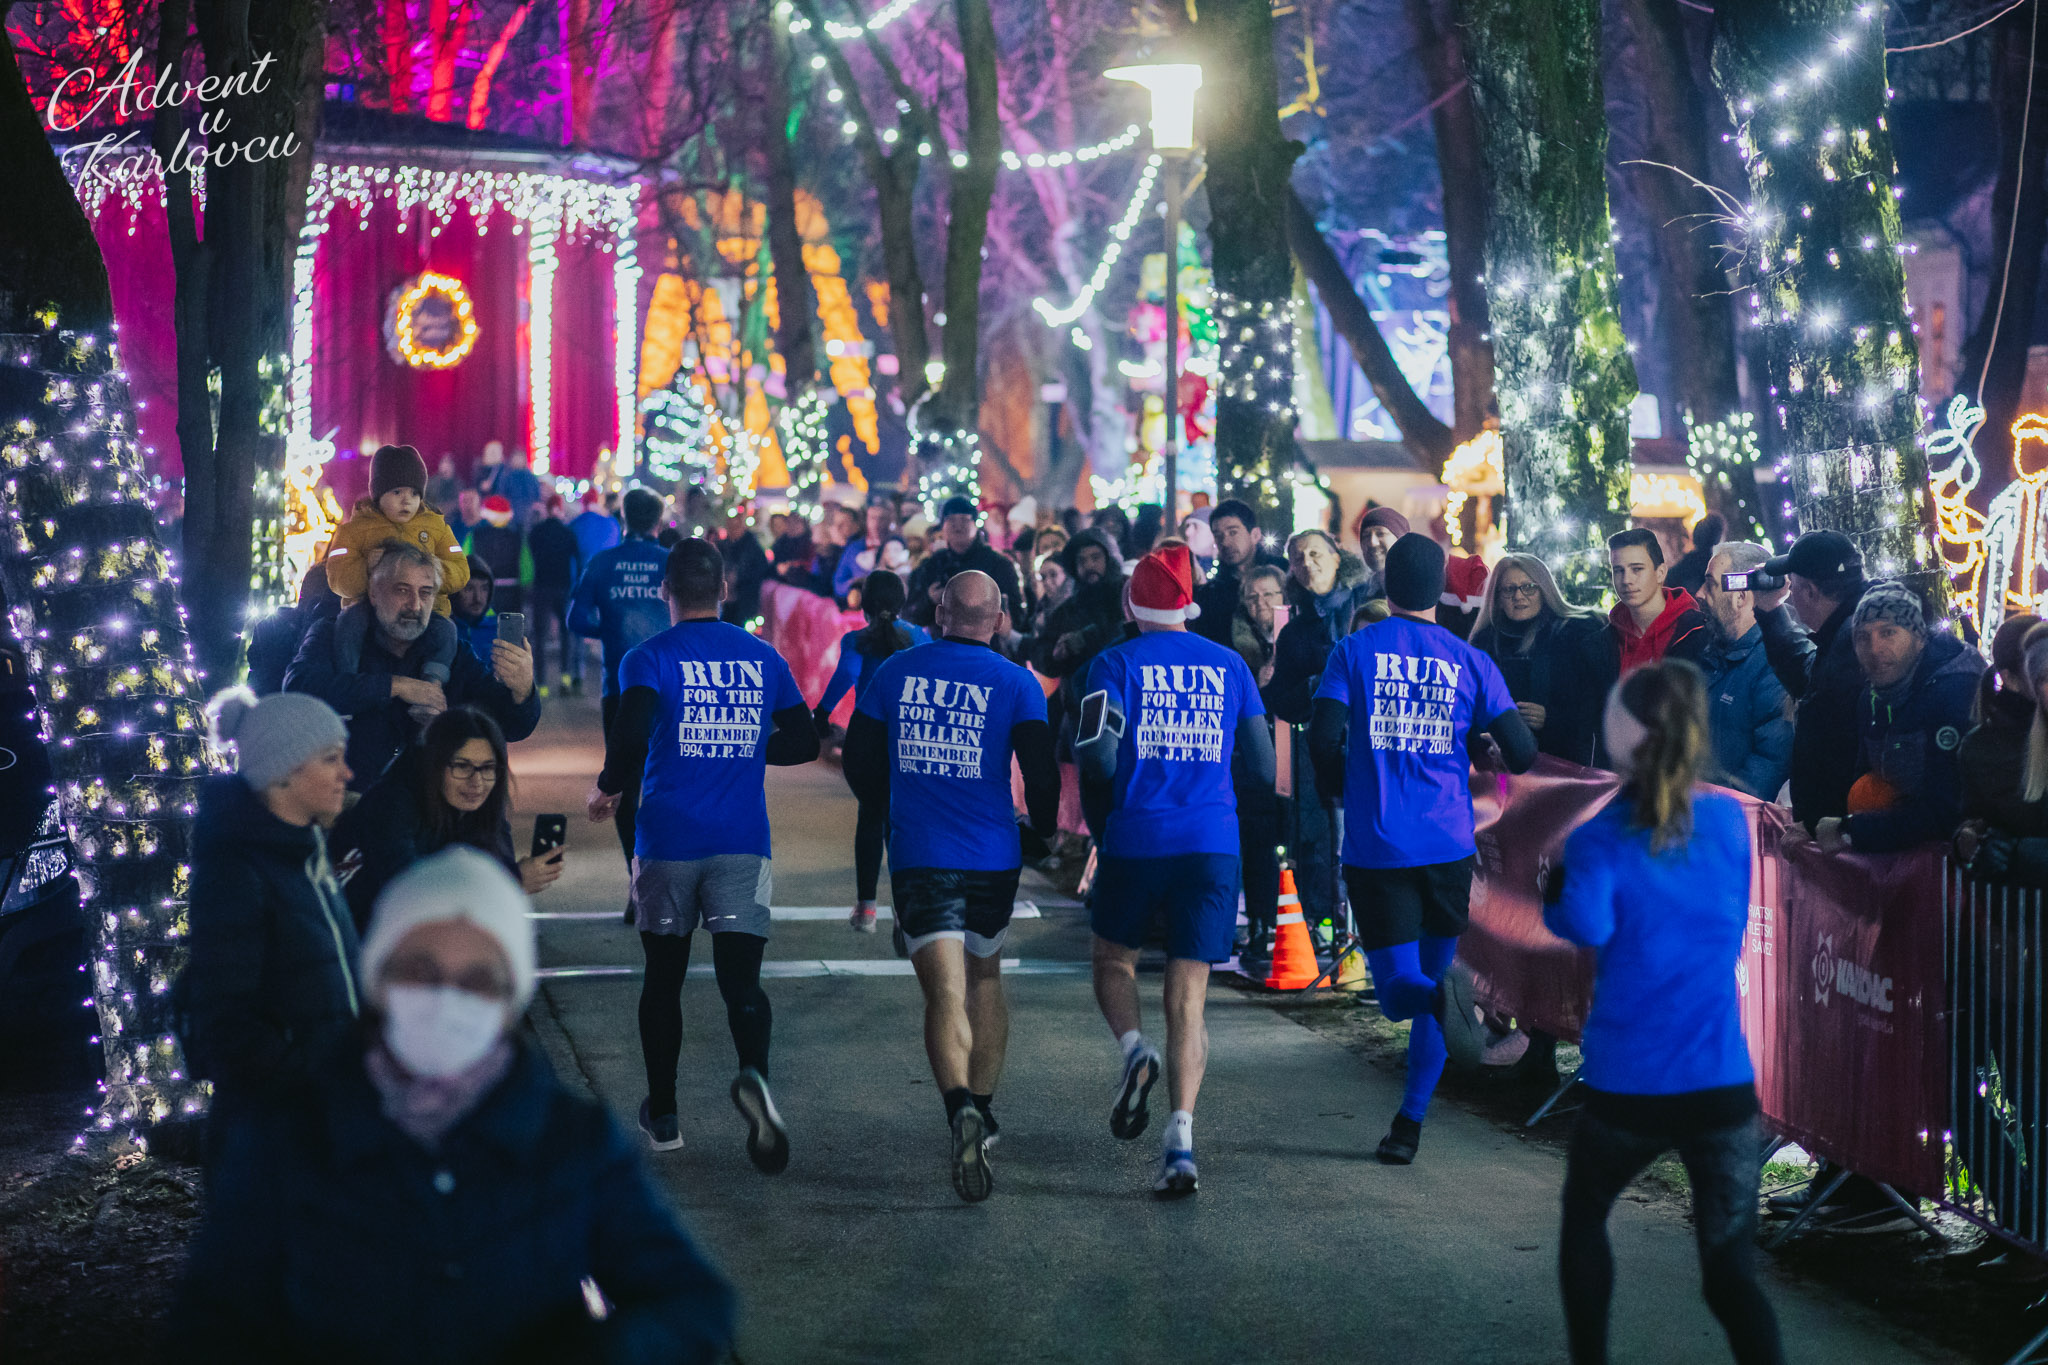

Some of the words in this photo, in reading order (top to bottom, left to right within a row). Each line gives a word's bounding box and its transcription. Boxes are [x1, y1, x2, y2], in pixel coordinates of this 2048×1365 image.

[615, 561, 659, 571] ATLETSKI
[623, 574, 650, 583] KLUB
[679, 660, 764, 688] RUN
[1374, 652, 1462, 688] RUN
[1140, 665, 1226, 695] RUN
[683, 688, 719, 704] FOR
[726, 689, 764, 705] THE
[899, 675, 993, 713] RUN
[1142, 692, 1178, 708] FOR
[1188, 693, 1224, 711] THE
[1374, 681, 1409, 698] FOR
[1419, 685, 1455, 703] THE
[682, 705, 763, 724] FALLEN
[899, 705, 935, 722] FOR
[946, 710, 986, 729] THE
[1141, 708, 1223, 730] FALLEN
[1373, 698, 1454, 721] FALLEN
[683, 727, 758, 742] REMEMBER
[900, 722, 982, 747] FALLEN
[1141, 730, 1220, 746] REMEMBER
[1374, 720, 1450, 737] REMEMBER
[707, 745, 734, 758] J.P.
[901, 743, 978, 763] REMEMBER
[1165, 747, 1195, 761] J.P.
[1396, 738, 1424, 753] J.P.
[1428, 740, 1454, 755] 2019.
[922, 762, 952, 777] J.P.
